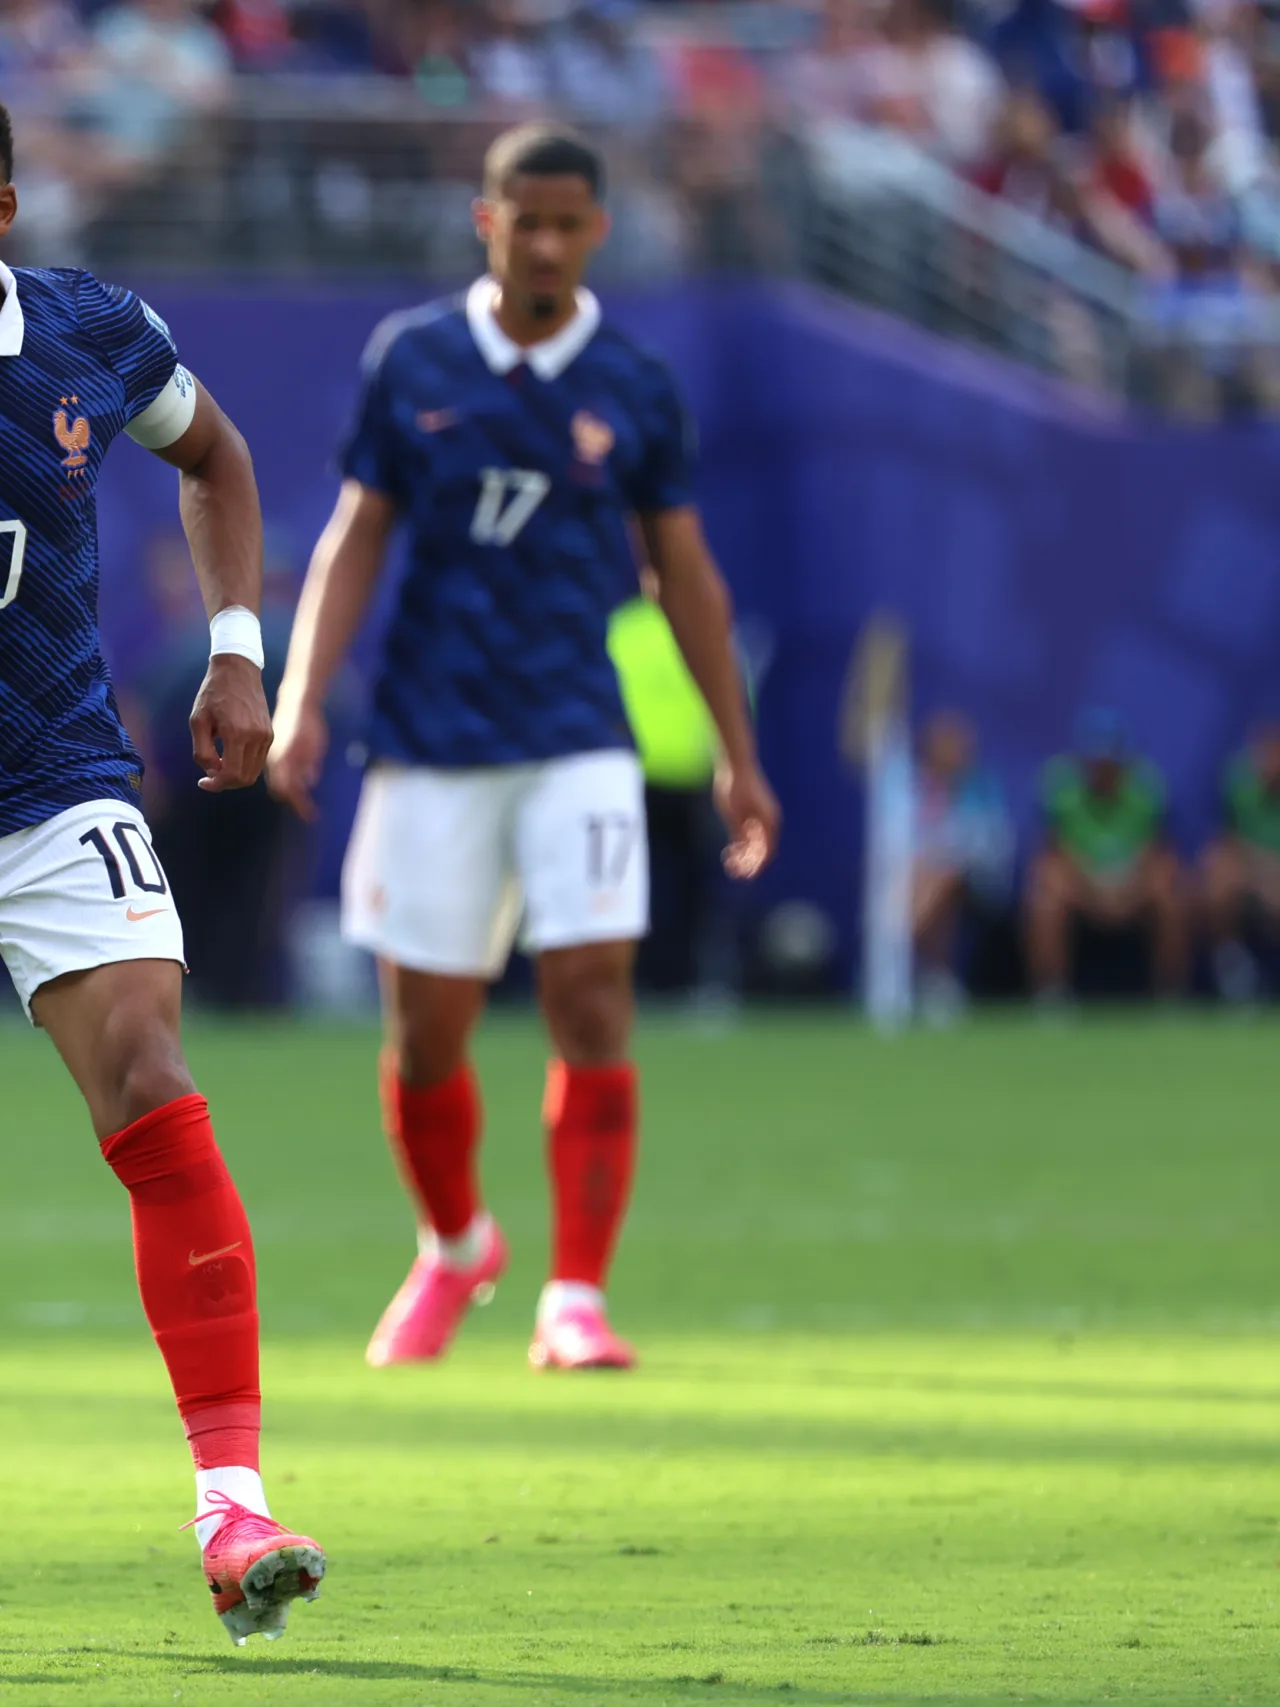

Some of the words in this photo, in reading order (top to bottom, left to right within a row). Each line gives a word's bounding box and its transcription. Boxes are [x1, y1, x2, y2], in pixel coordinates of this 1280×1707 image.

[469, 467, 551, 547] 17
[78, 821, 167, 900] 10
[580, 810, 641, 887] 17
